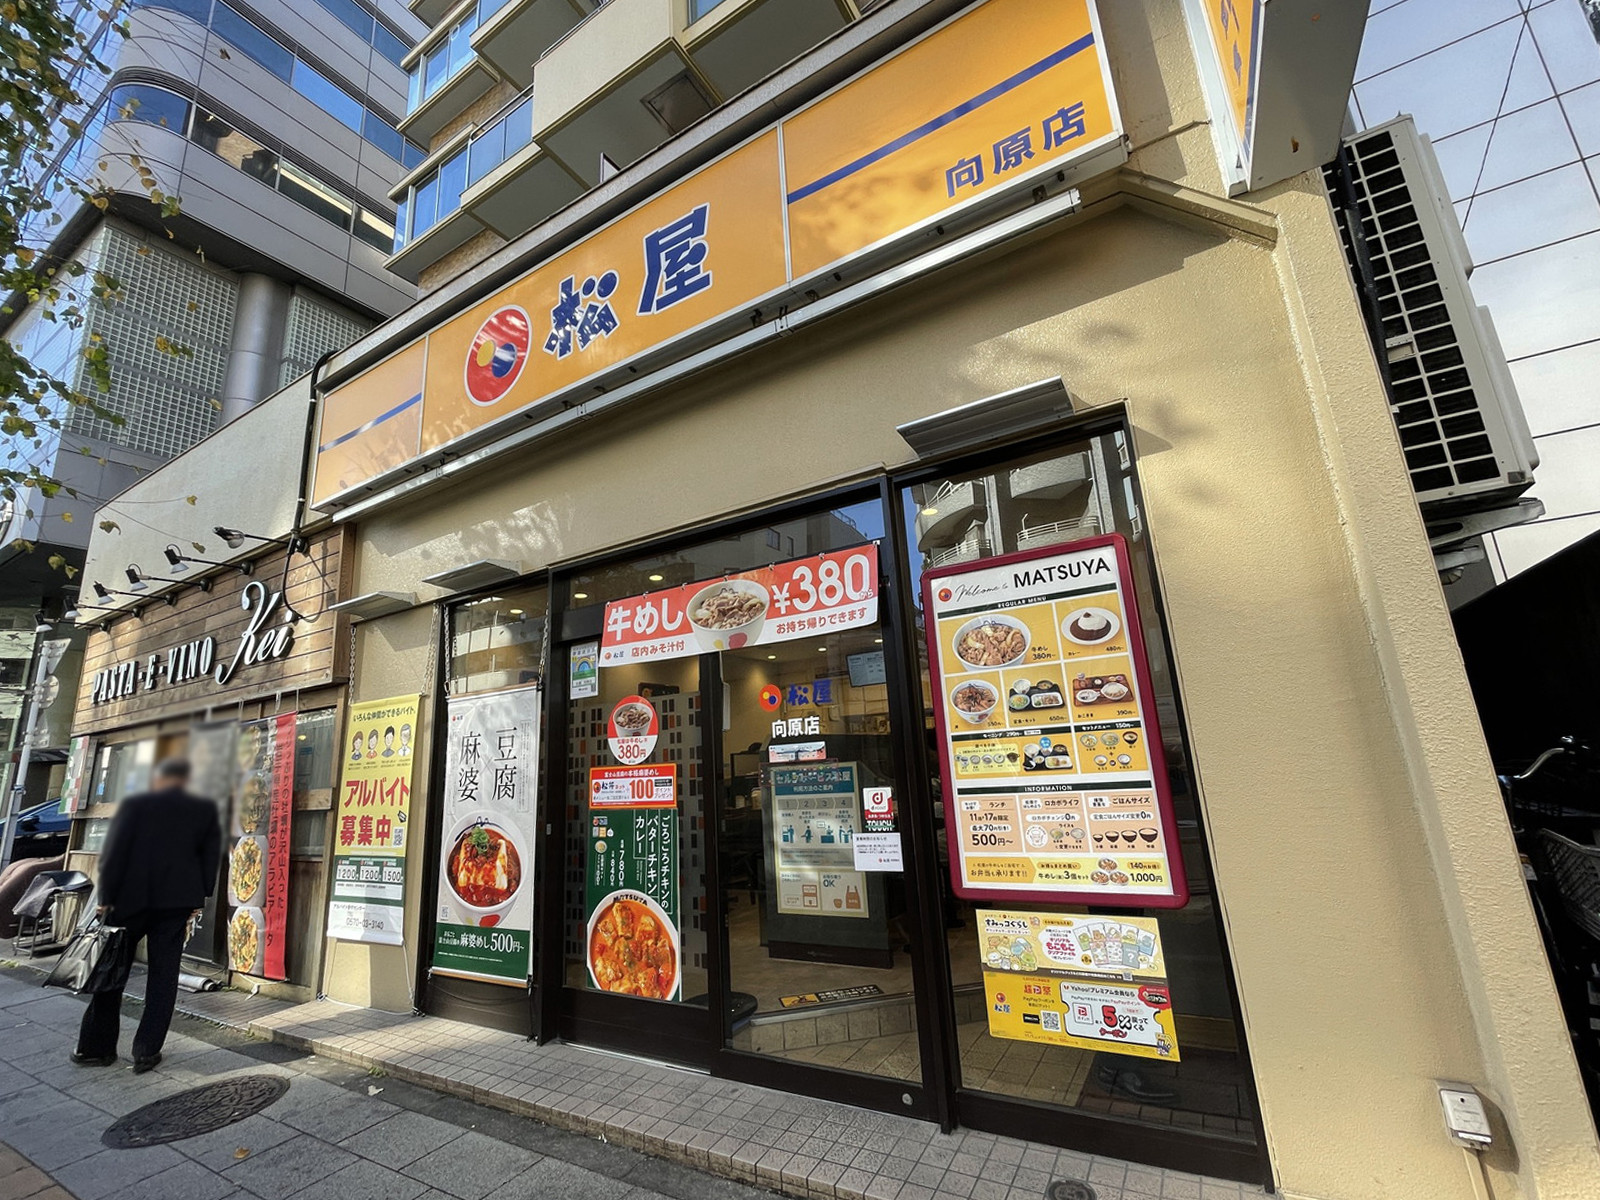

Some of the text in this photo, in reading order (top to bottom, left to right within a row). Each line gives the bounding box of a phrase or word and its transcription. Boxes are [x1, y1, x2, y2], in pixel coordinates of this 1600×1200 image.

[945, 101, 1086, 198] 向原店
[543, 202, 712, 361] 松屋
[1013, 557, 1112, 588] MATSUYA
[955, 584, 1000, 603] Welcome
[998, 599, 1026, 608] REGULAR
[215, 581, 294, 685] Kei
[607, 598, 684, 641] 牛めし
[776, 606, 868, 635] お持ち帰りできます
[630, 641, 685, 658] 店内みそ汁付
[787, 679, 832, 706] 松屋
[772, 716, 820, 738] 向原店
[491, 726, 517, 801] 豆腐
[618, 744, 647, 760] 380円
[458, 731, 481, 803] 麻婆
[344, 777, 410, 808] アルバイト
[630, 779, 654, 799] 100
[1024, 785, 1073, 793] INFORMATION
[340, 815, 392, 846] 募集中
[636, 815, 645, 854] カレー
[647, 815, 658, 894] バターチキン
[661, 815, 671, 909] ごろごろチキンの
[823, 879, 835, 888] OK
[985, 919, 1028, 929] すみっコぐらし
[1045, 942, 1075, 951] もこもこ
[994, 1004, 1011, 1013] 松屋
